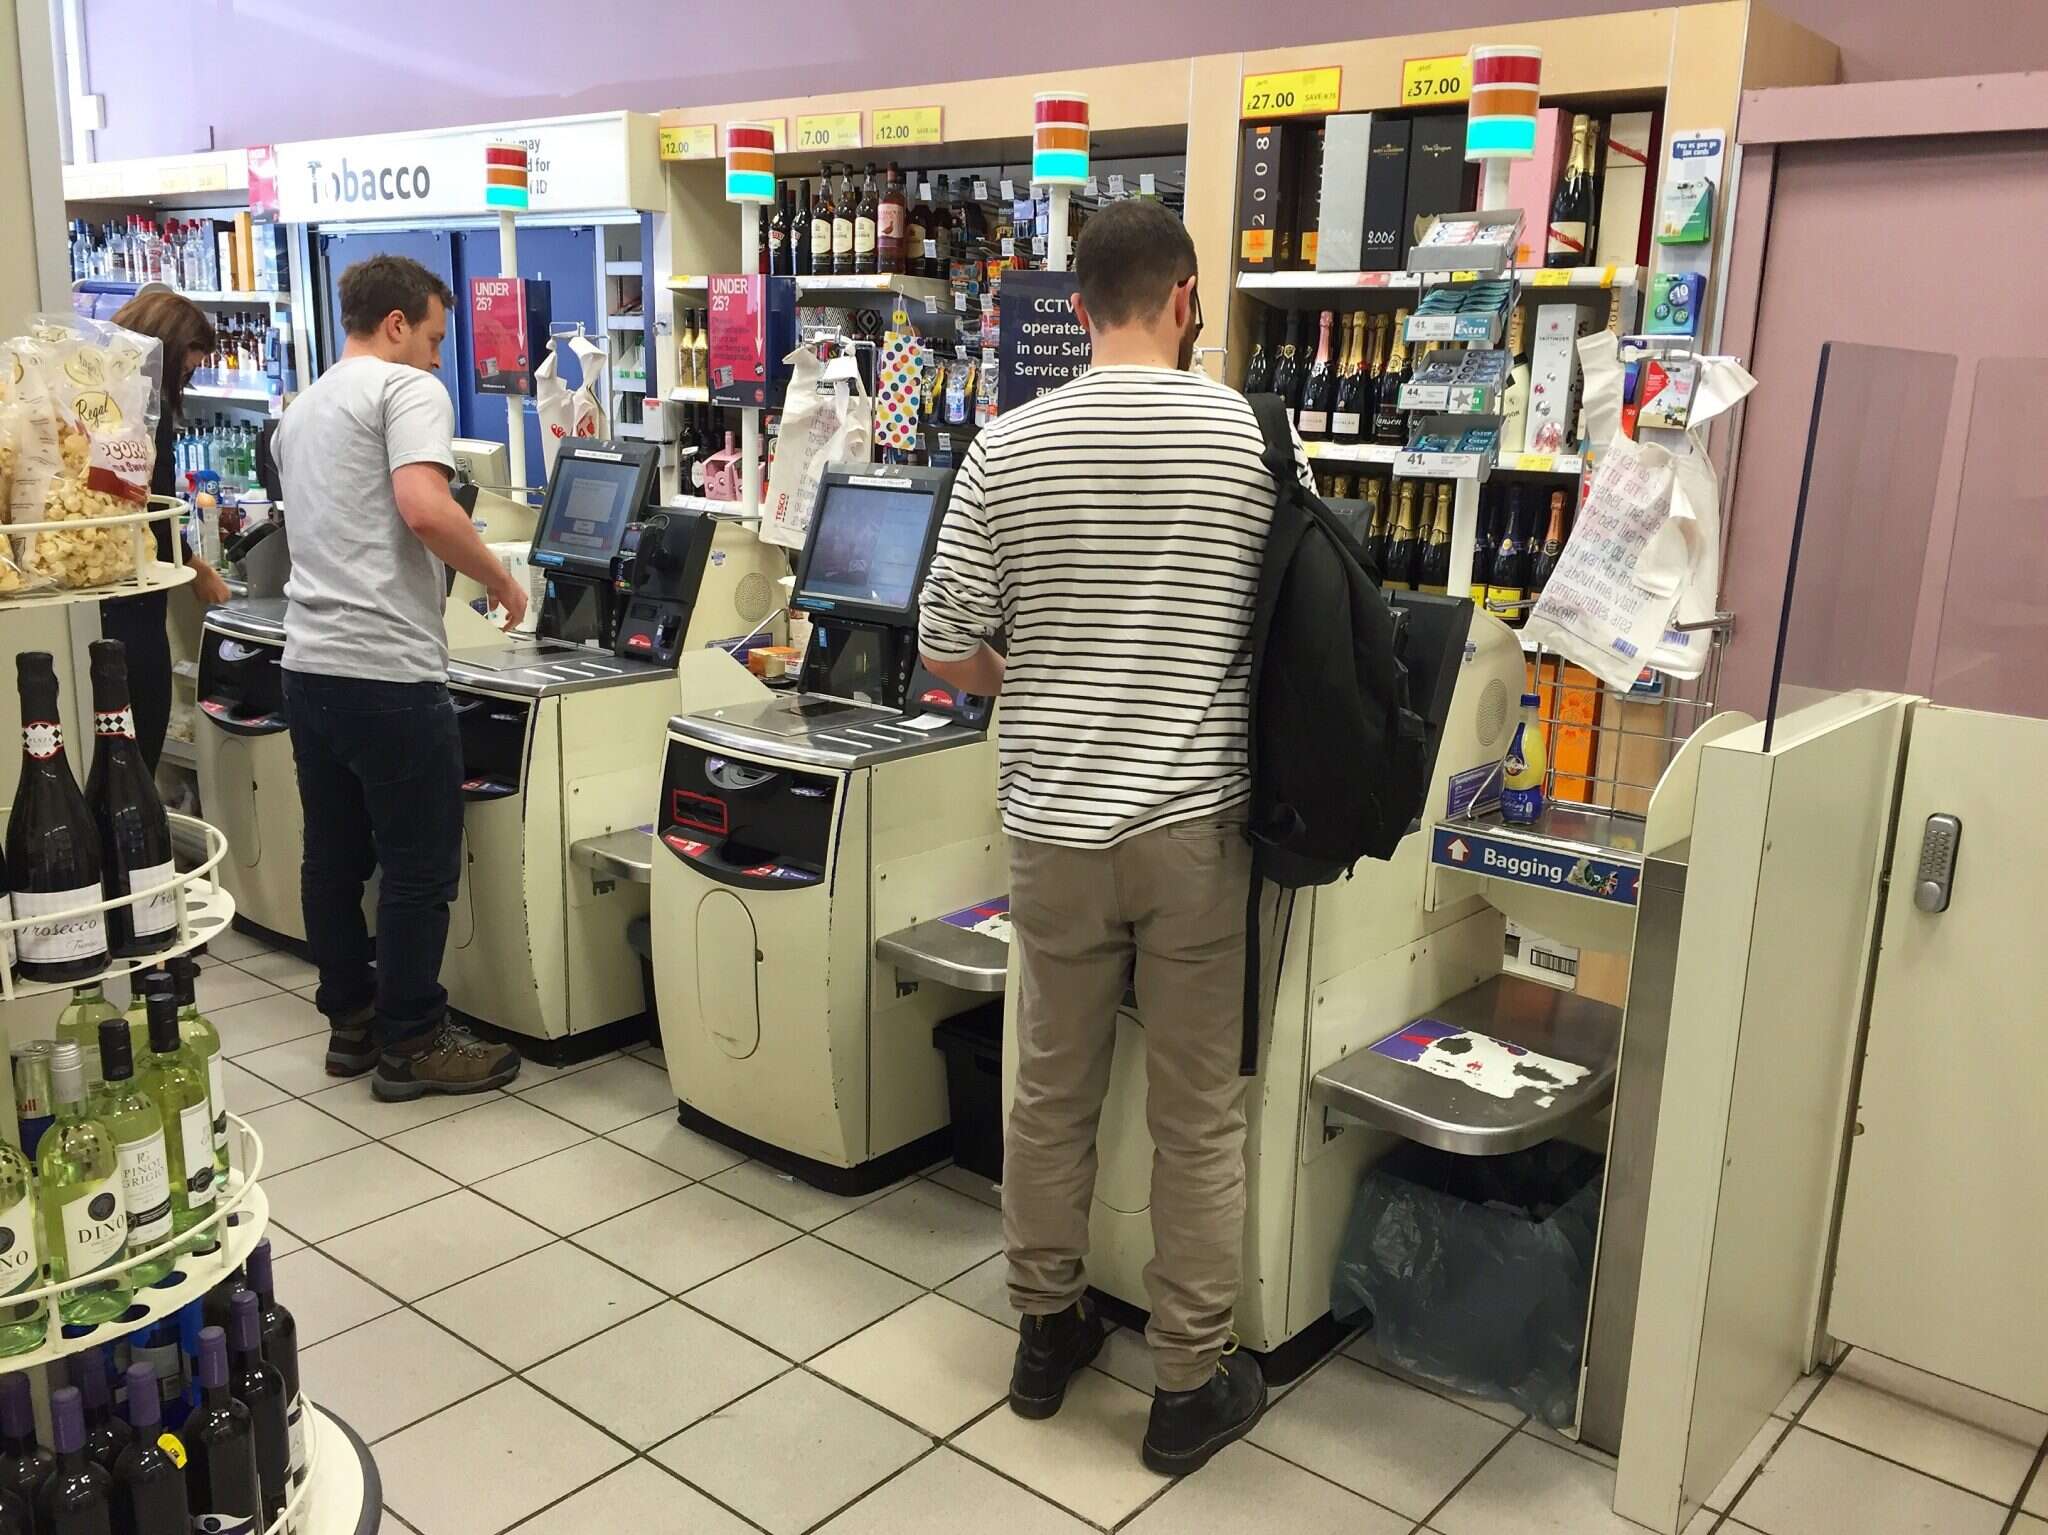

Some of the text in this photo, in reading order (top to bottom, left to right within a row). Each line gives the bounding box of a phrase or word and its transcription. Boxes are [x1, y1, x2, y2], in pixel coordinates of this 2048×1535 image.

[1408, 77, 1460, 97] £37.00
[1247, 92, 1295, 110] £27.00
[1367, 230, 1397, 245] 2006
[475, 282, 509, 297] UNDER
[712, 278, 748, 295] UNDER
[476, 297, 492, 311] 25?
[712, 295, 730, 311] 25?
[1034, 298, 1074, 313] CCTV
[1022, 322, 1086, 337] operates
[1456, 324, 1486, 334] Extra
[1017, 341, 1091, 356] in our Self
[1014, 362, 1069, 376] Service
[76, 390, 110, 428] Regal
[775, 492, 787, 522] TESCO
[1625, 553, 1638, 569] ca
[1483, 848, 1563, 883] Bagging
[122, 1157, 162, 1179] PINOT
[122, 1166, 164, 1189] GRIGIO
[78, 1214, 125, 1244] DINO
[0, 1250, 28, 1269] NO
